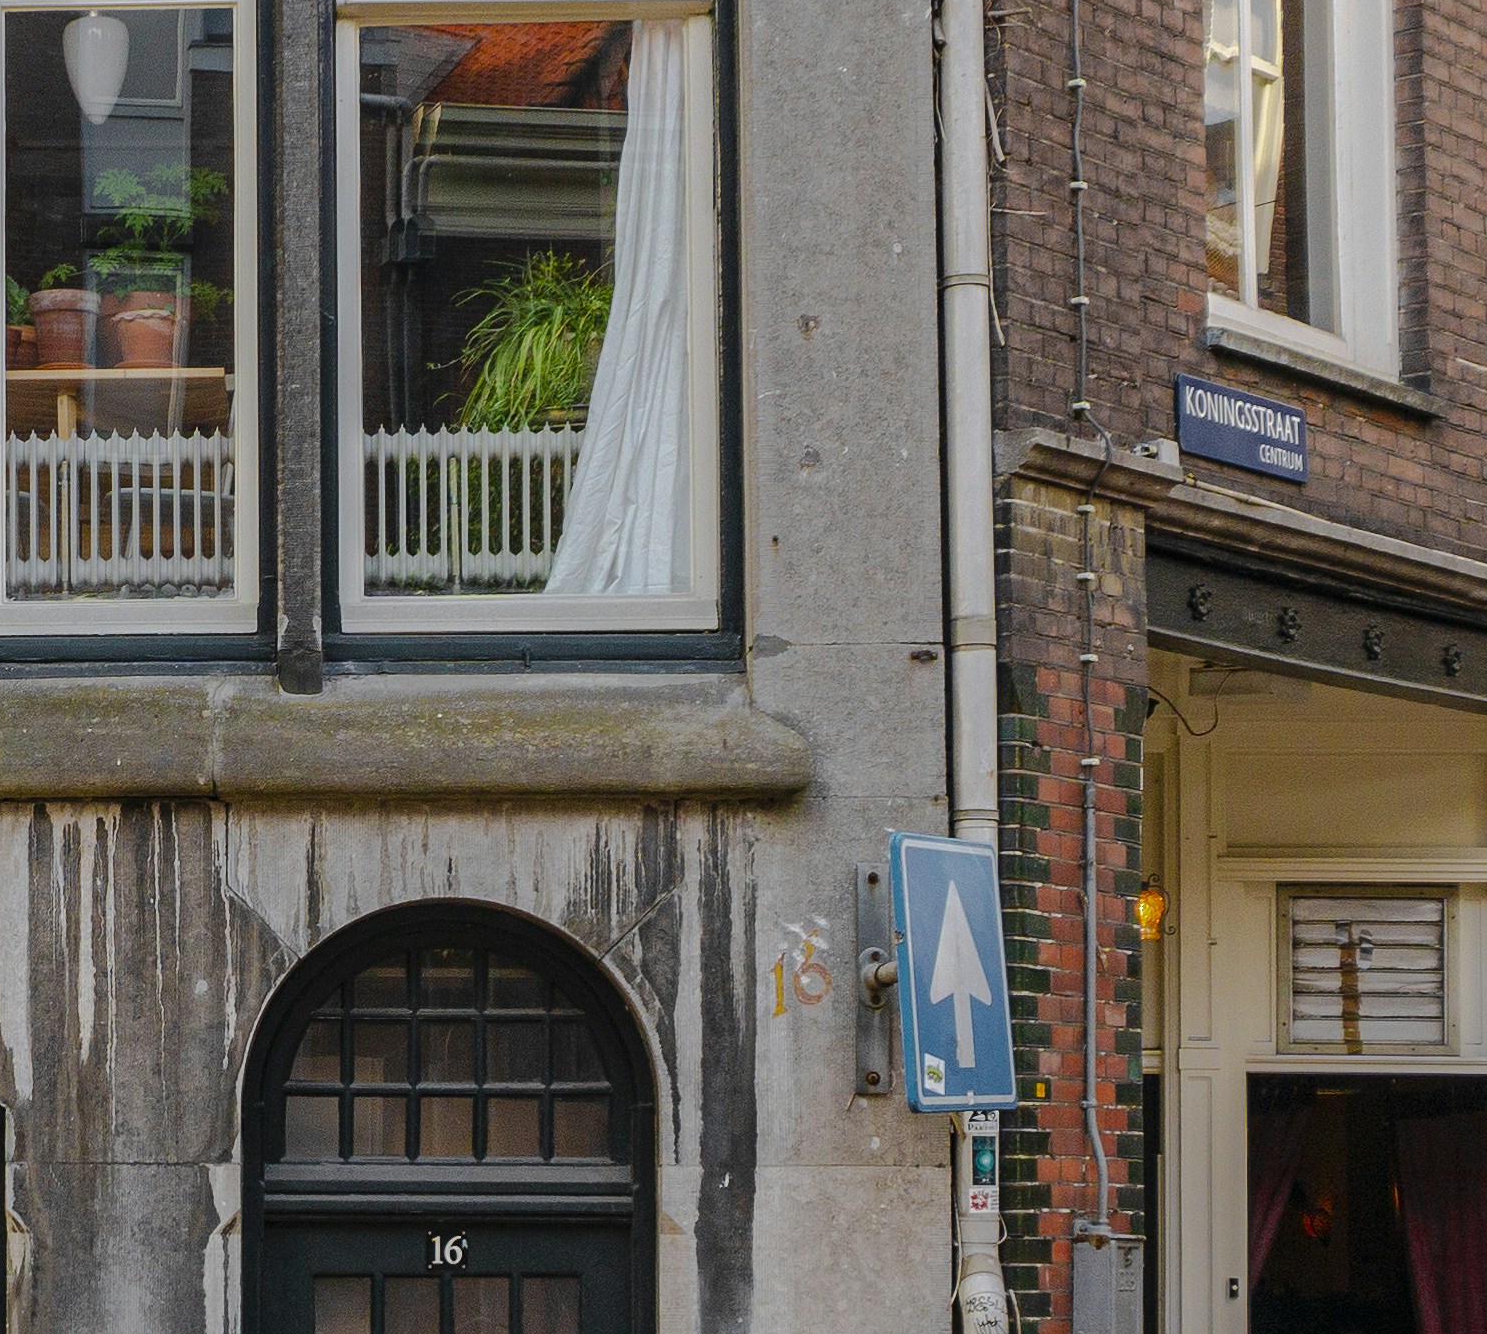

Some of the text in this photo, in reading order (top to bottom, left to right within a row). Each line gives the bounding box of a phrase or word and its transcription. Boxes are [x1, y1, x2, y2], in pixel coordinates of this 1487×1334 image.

[1185, 385, 1301, 446] KONINGSSTRAAT
[1259, 443, 1304, 472] CENTRUM
[431, 1235, 464, 1265] 16
